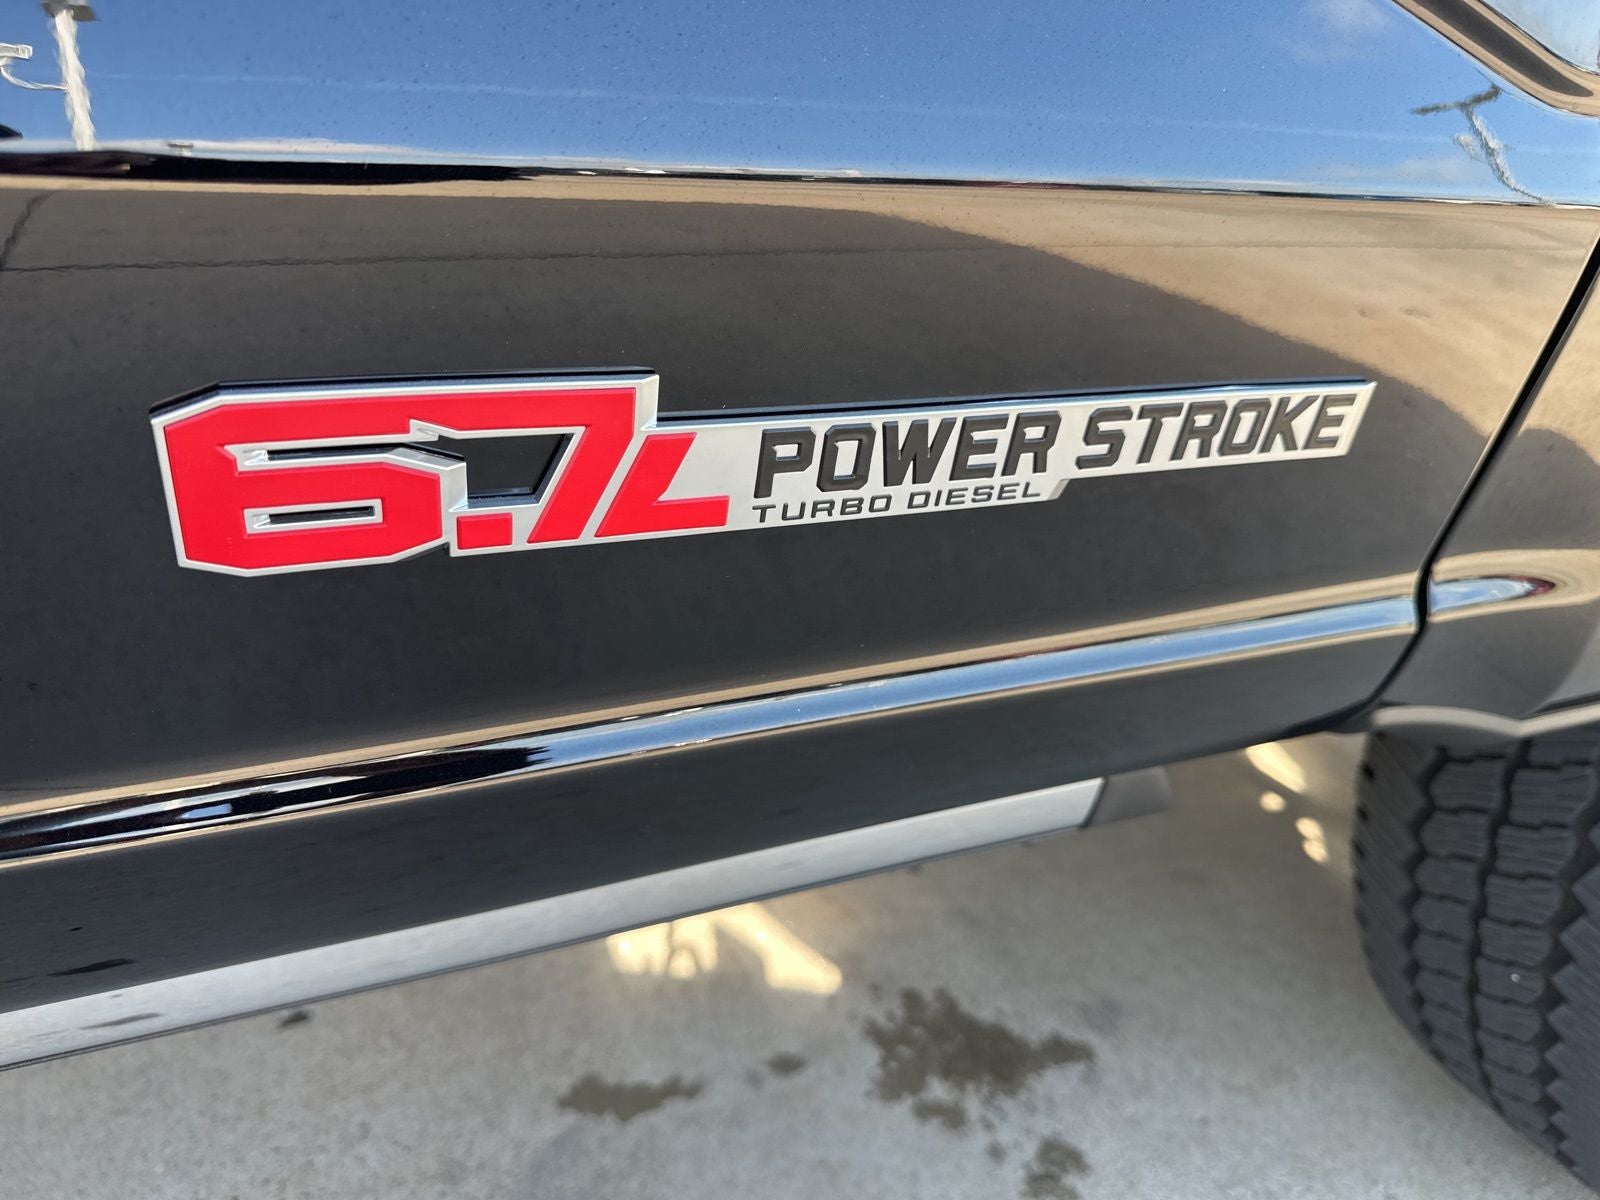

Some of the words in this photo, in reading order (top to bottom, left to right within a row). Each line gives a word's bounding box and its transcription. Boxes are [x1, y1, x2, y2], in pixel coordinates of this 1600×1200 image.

[163, 387, 730, 570] 6.7L
[753, 410, 1062, 499] POWER
[1074, 393, 1358, 470] STROKE
[752, 493, 892, 523] TURBO
[907, 481, 1041, 509] DIESEL
